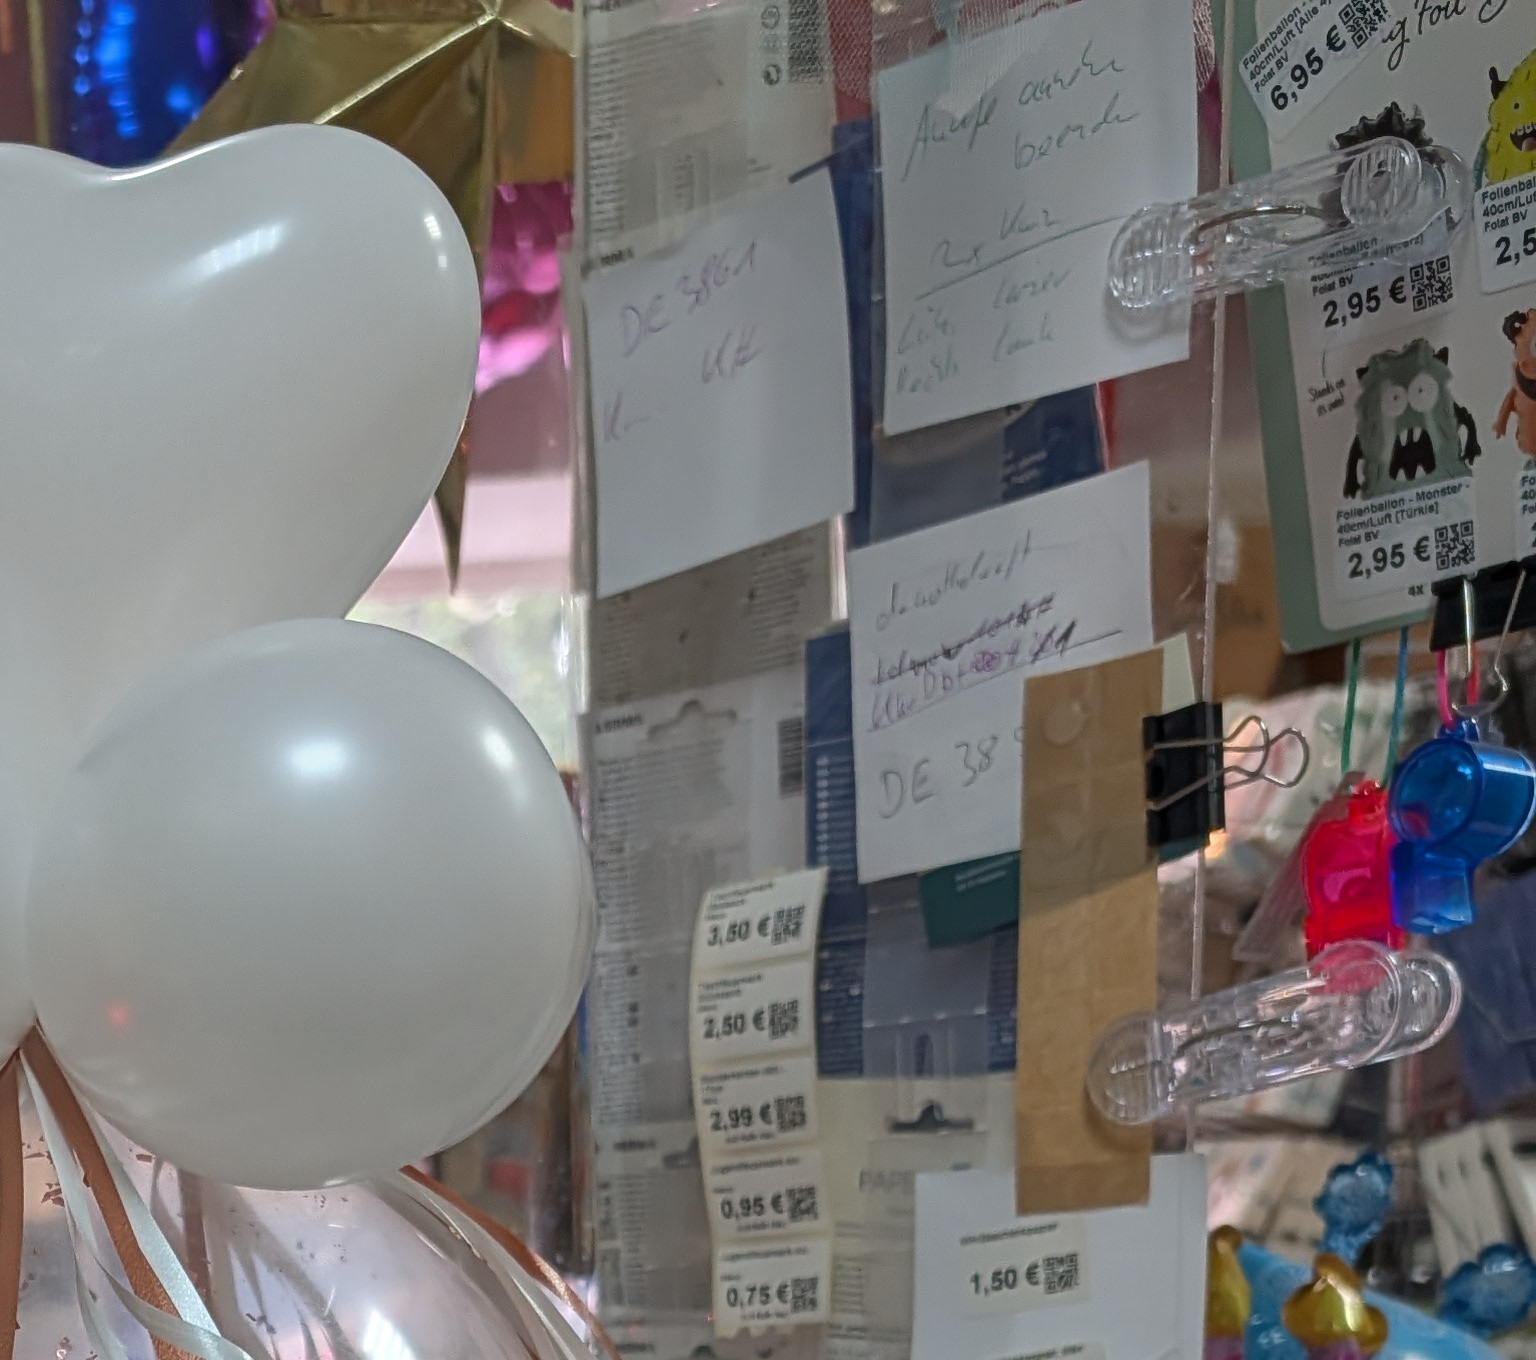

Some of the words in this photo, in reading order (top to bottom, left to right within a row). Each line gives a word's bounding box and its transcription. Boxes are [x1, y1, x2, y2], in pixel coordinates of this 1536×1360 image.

[1242, 7, 1301, 70] Folienballon
[1270, 47, 1324, 110] 6,95
[1325, 25, 1347, 52] €
[1484, 215, 1510, 232] Folat
[1512, 209, 1529, 224] BV
[1322, 285, 1381, 328] 2,95
[1388, 276, 1407, 304] €
[1336, 496, 1405, 521] Folienballon
[1415, 483, 1462, 502] Monster
[1348, 542, 1405, 579] 2,95
[1412, 535, 1431, 563] €
[758, 1102, 773, 1125] €
[770, 1193, 784, 1215] €
[776, 1282, 790, 1304] €
[970, 1267, 1017, 1297] 1,50
[1025, 1261, 1040, 1287] €
